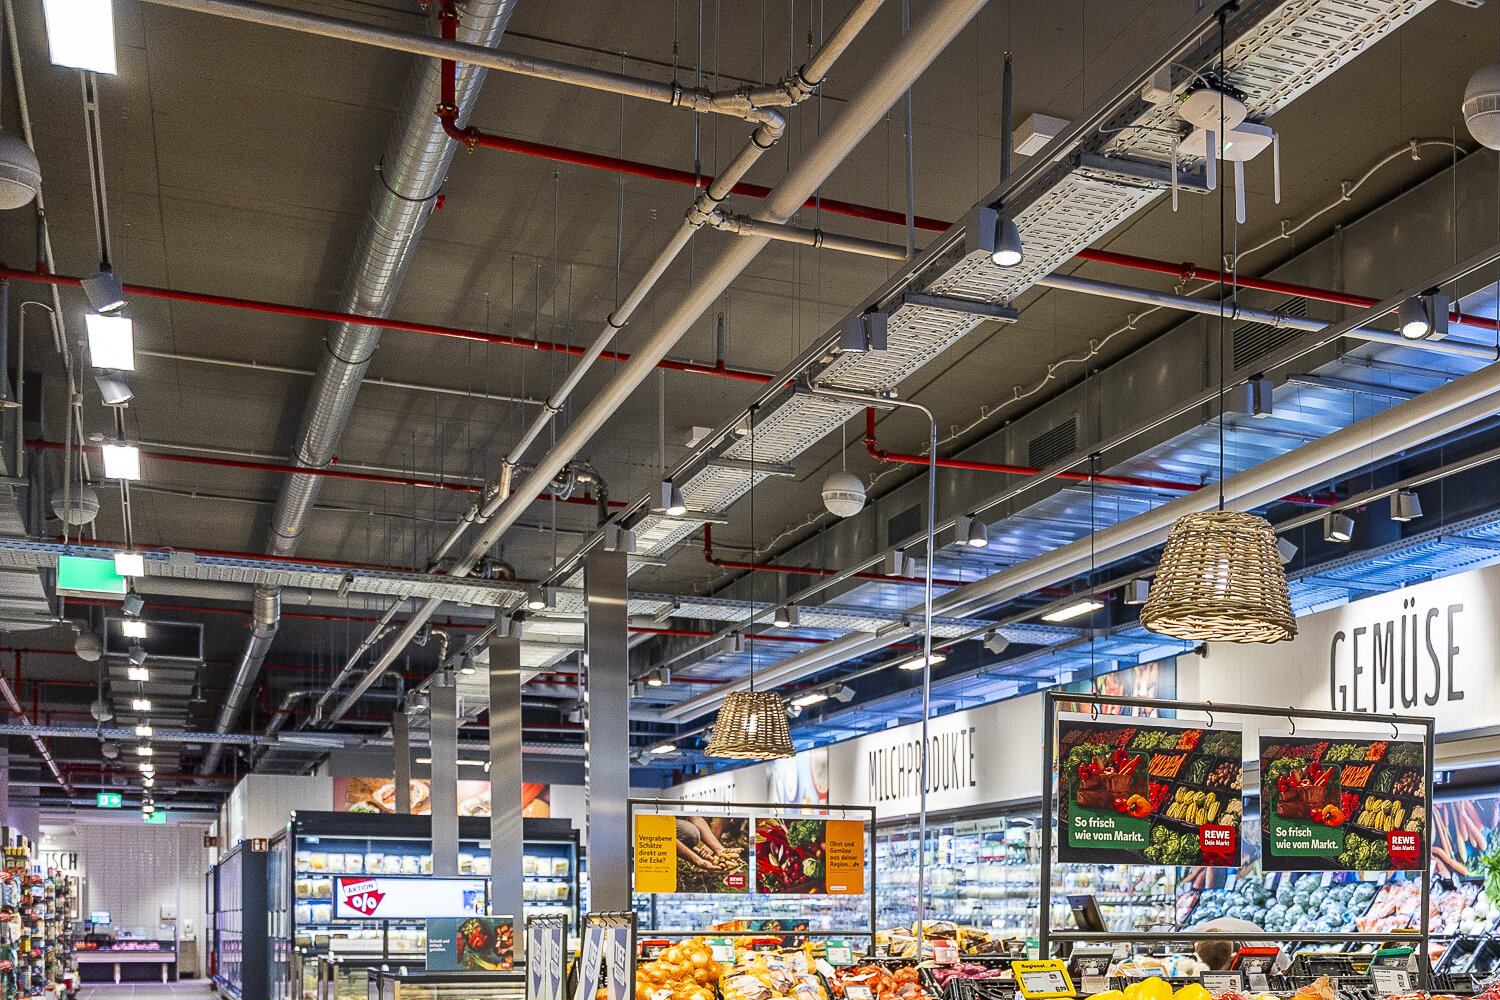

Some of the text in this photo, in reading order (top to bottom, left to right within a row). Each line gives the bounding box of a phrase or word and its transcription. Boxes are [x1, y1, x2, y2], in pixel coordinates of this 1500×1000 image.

[1330, 597, 1464, 713] GEMÜSE
[869, 727, 976, 803] MILCHPRODUKTE
[1074, 817, 1115, 828] So frisch
[1074, 830, 1145, 842] wie vom Markt.
[1204, 830, 1230, 839] REWE
[1275, 827, 1312, 837] So frisch
[638, 834, 672, 842] Vergrabene
[1392, 836, 1415, 844] REWE
[639, 841, 662, 849] Schätze
[1275, 839, 1339, 849] wie vom Markt.
[46, 853, 77, 870] ISCH
[348, 883, 374, 894] AKTION
